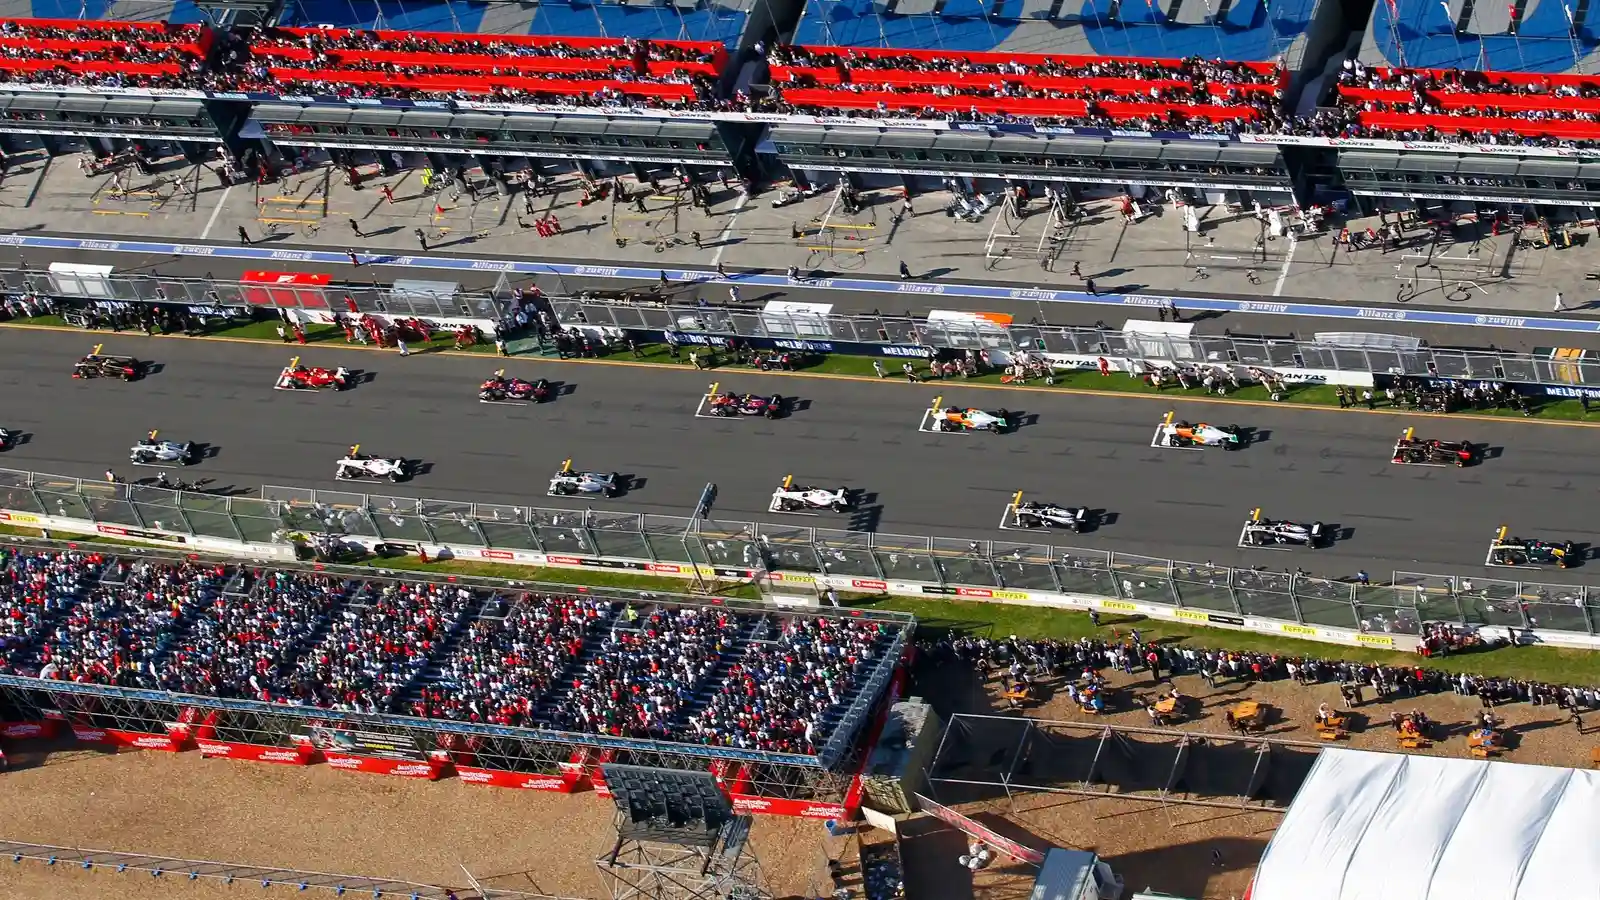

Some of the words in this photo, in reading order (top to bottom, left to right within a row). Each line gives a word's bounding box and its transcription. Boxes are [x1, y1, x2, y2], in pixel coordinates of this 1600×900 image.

[79, 240, 109, 249] Allianz
[271, 251, 303, 260] Allianz
[472, 260, 505, 270] Allianz
[585, 267, 620, 276] Allianz
[898, 284, 932, 293] Allianz
[1021, 290, 1058, 300] Allianz
[1123, 296, 1160, 305] Allianz
[1250, 303, 1288, 312] Allianz
[1356, 309, 1394, 319] Allianz
[1487, 317, 1526, 327] Allianz
[1545, 387, 1600, 398] MELBORN
